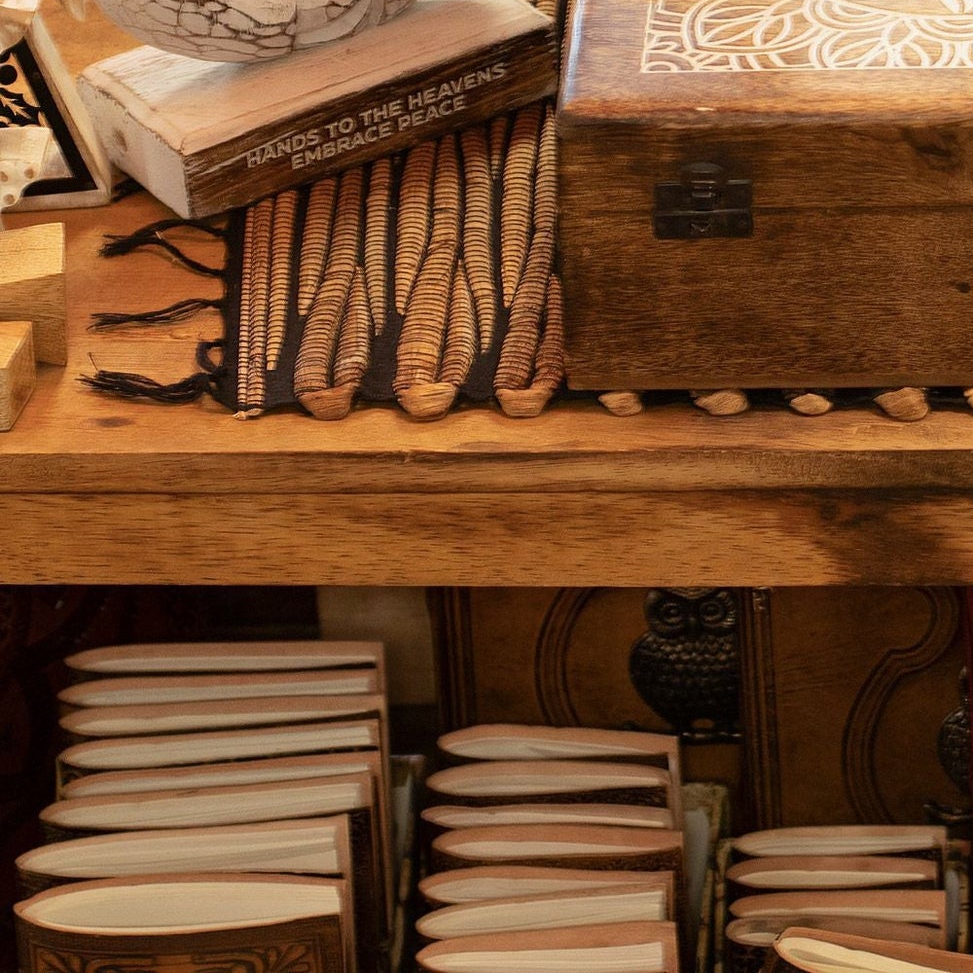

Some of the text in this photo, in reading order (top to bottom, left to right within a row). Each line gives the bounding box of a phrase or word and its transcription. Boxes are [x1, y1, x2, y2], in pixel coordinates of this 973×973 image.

[246, 63, 505, 168] HANDS TO THE HEAVENS
[291, 95, 466, 169] EMBRACE PEACE
